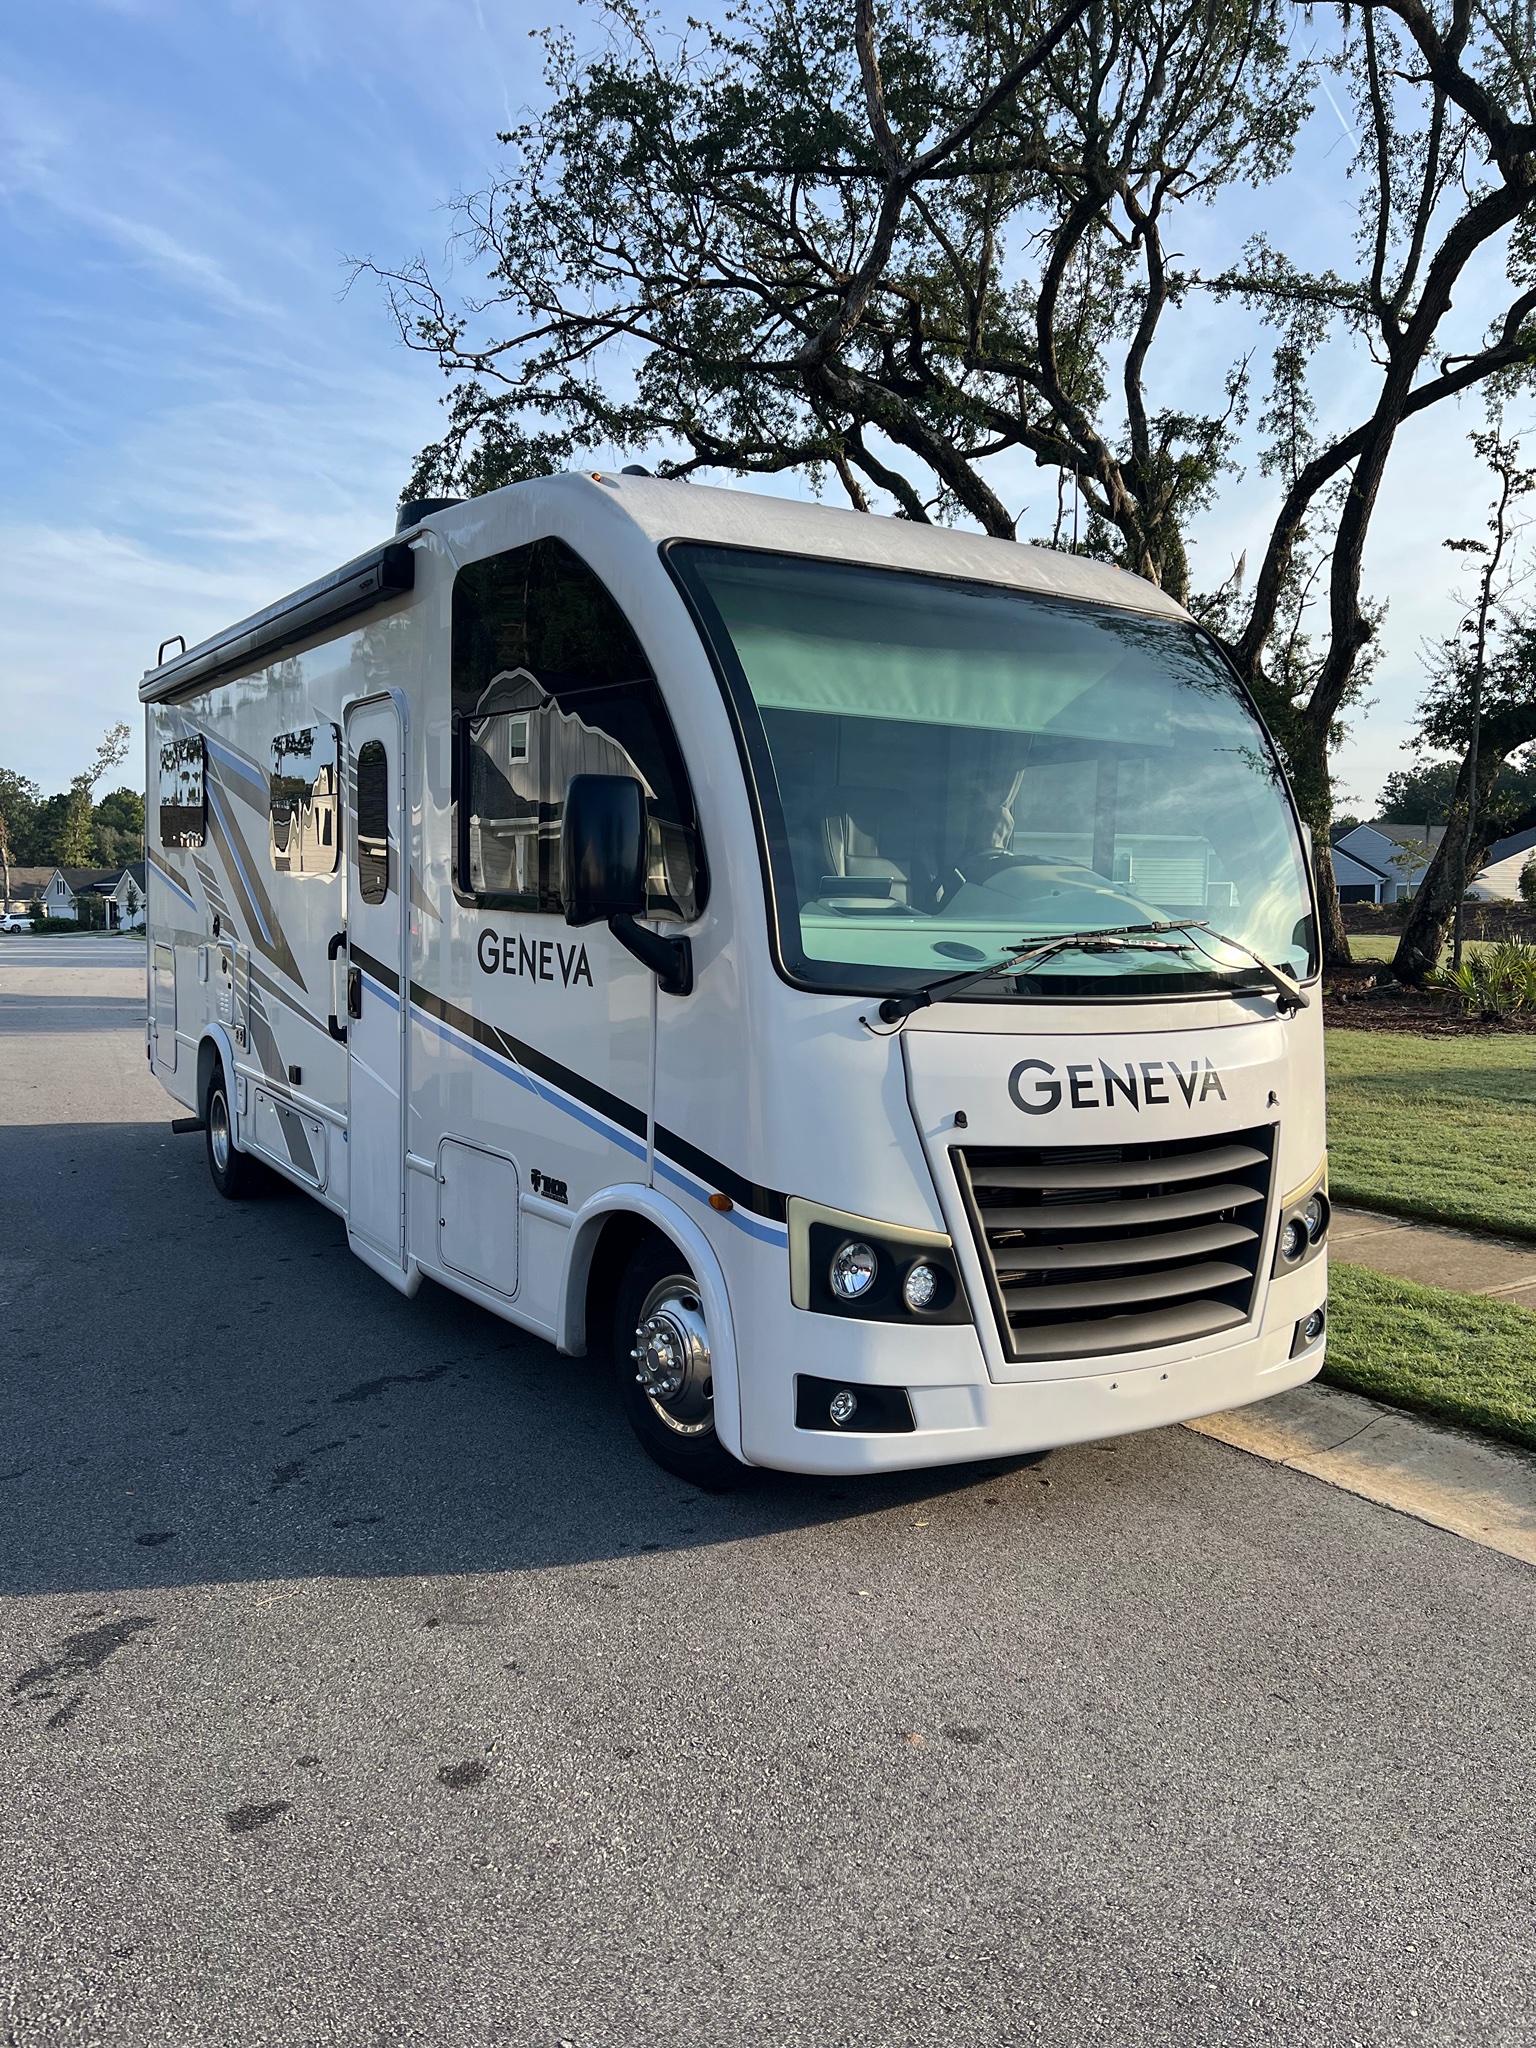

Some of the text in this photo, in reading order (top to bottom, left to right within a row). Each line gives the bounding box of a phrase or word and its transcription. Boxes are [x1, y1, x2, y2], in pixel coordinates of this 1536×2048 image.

[477, 928, 594, 989] GENEVA
[1008, 1056, 1227, 1115] GENEVA
[541, 1174, 567, 1199] THOR
